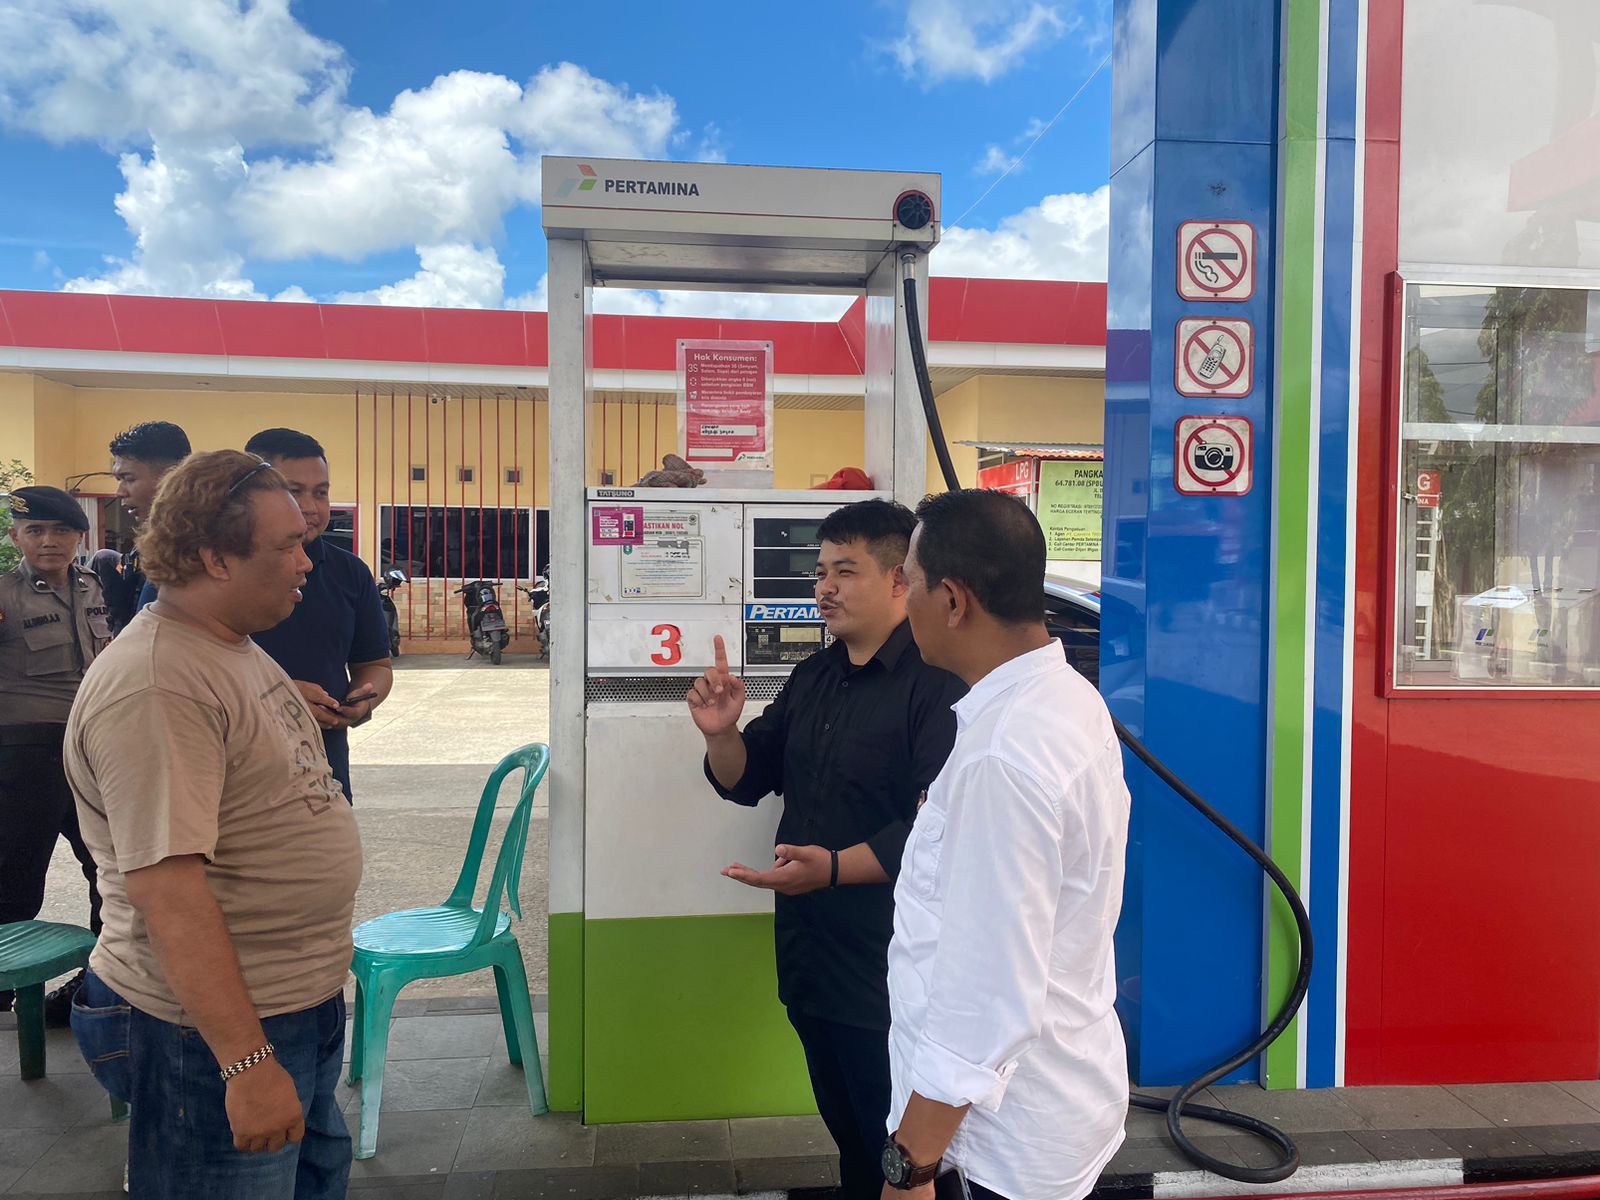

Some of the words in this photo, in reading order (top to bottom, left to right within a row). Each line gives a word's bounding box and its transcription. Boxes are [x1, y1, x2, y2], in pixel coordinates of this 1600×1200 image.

[604, 179, 699, 196] PERTAMINA
[694, 353, 710, 361] Hak
[712, 354, 758, 362] Konsumen:
[1015, 461, 1029, 481] LPG
[1417, 473, 1431, 491] G
[651, 623, 682, 666] 3
